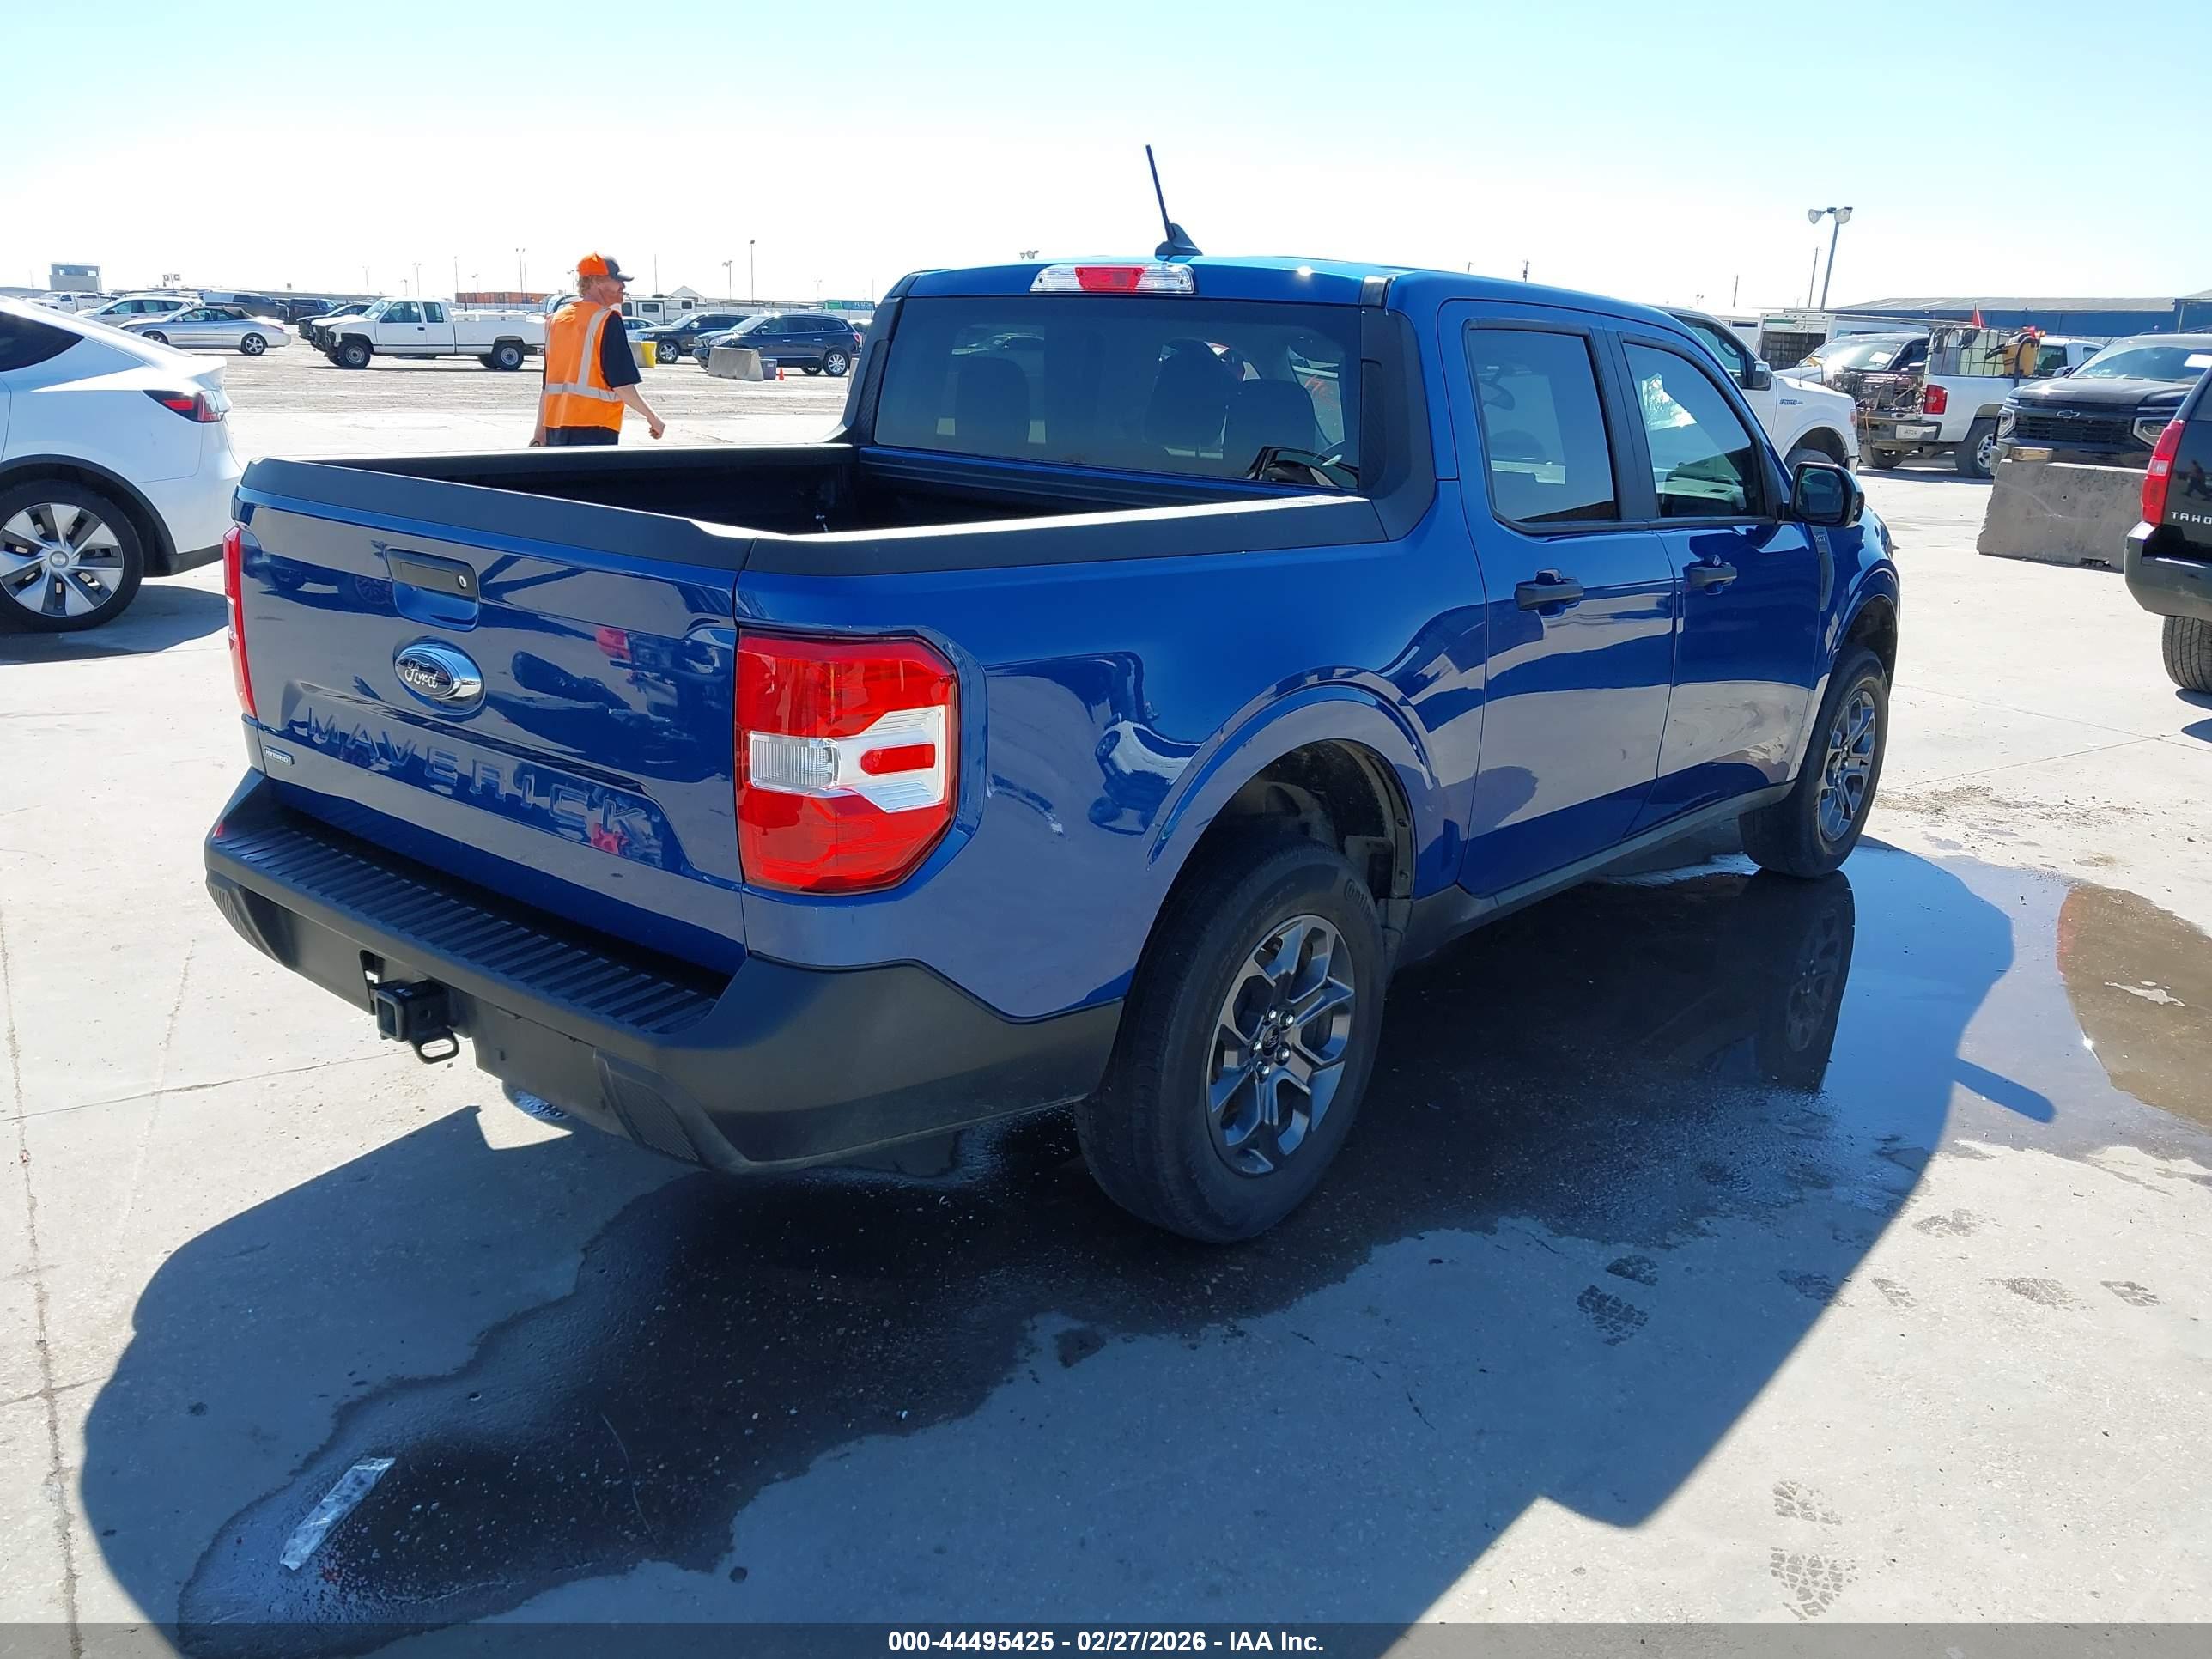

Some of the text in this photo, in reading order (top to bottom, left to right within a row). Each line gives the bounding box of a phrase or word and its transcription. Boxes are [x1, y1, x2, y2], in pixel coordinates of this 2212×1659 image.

[404, 658, 440, 689] Ford
[265, 749, 289, 763] HYBRID
[308, 706, 651, 842] MAVERICK
